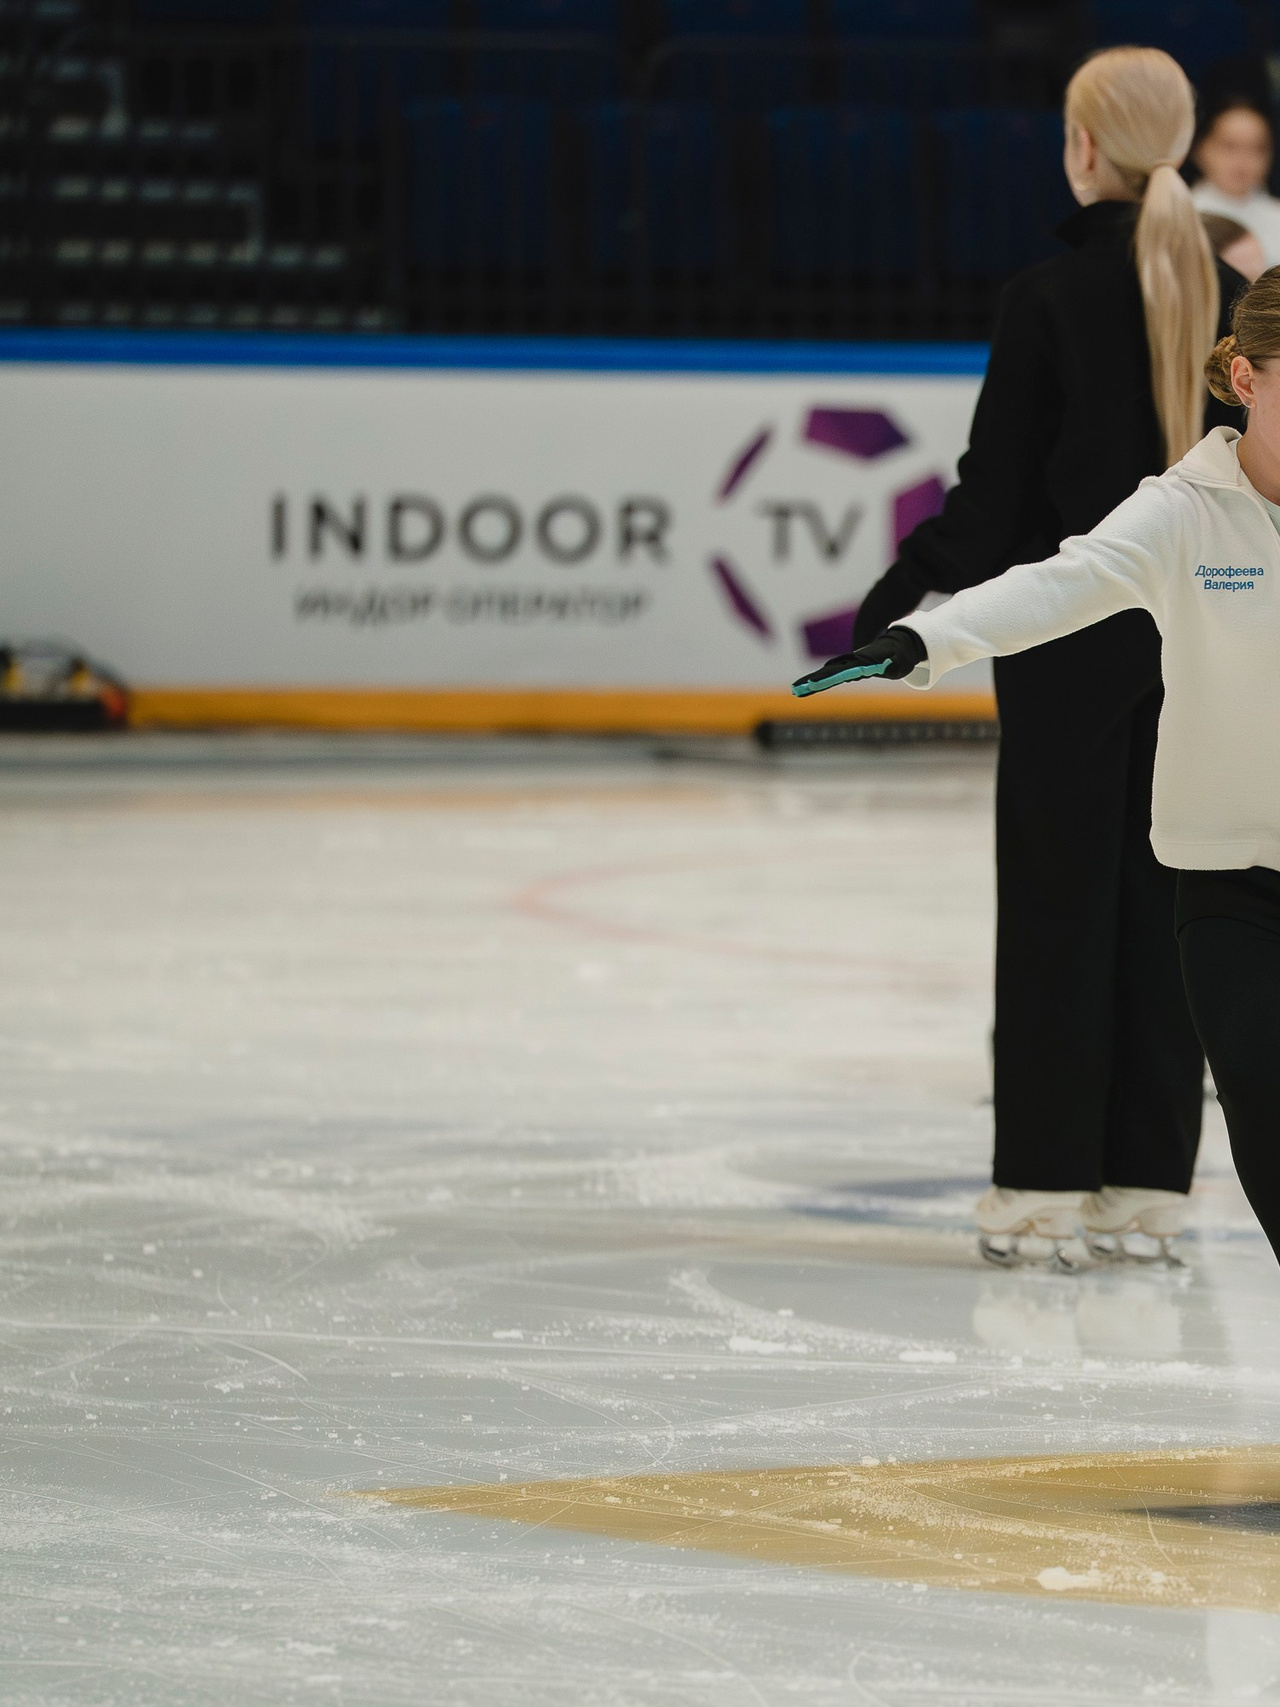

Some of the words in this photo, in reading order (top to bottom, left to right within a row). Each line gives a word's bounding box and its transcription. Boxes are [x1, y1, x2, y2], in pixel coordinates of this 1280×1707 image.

[271, 494, 672, 564] INDOOR
[756, 502, 862, 562] TV
[1194, 565, 1264, 579] Дорофеева
[1204, 579, 1254, 592] Валерия
